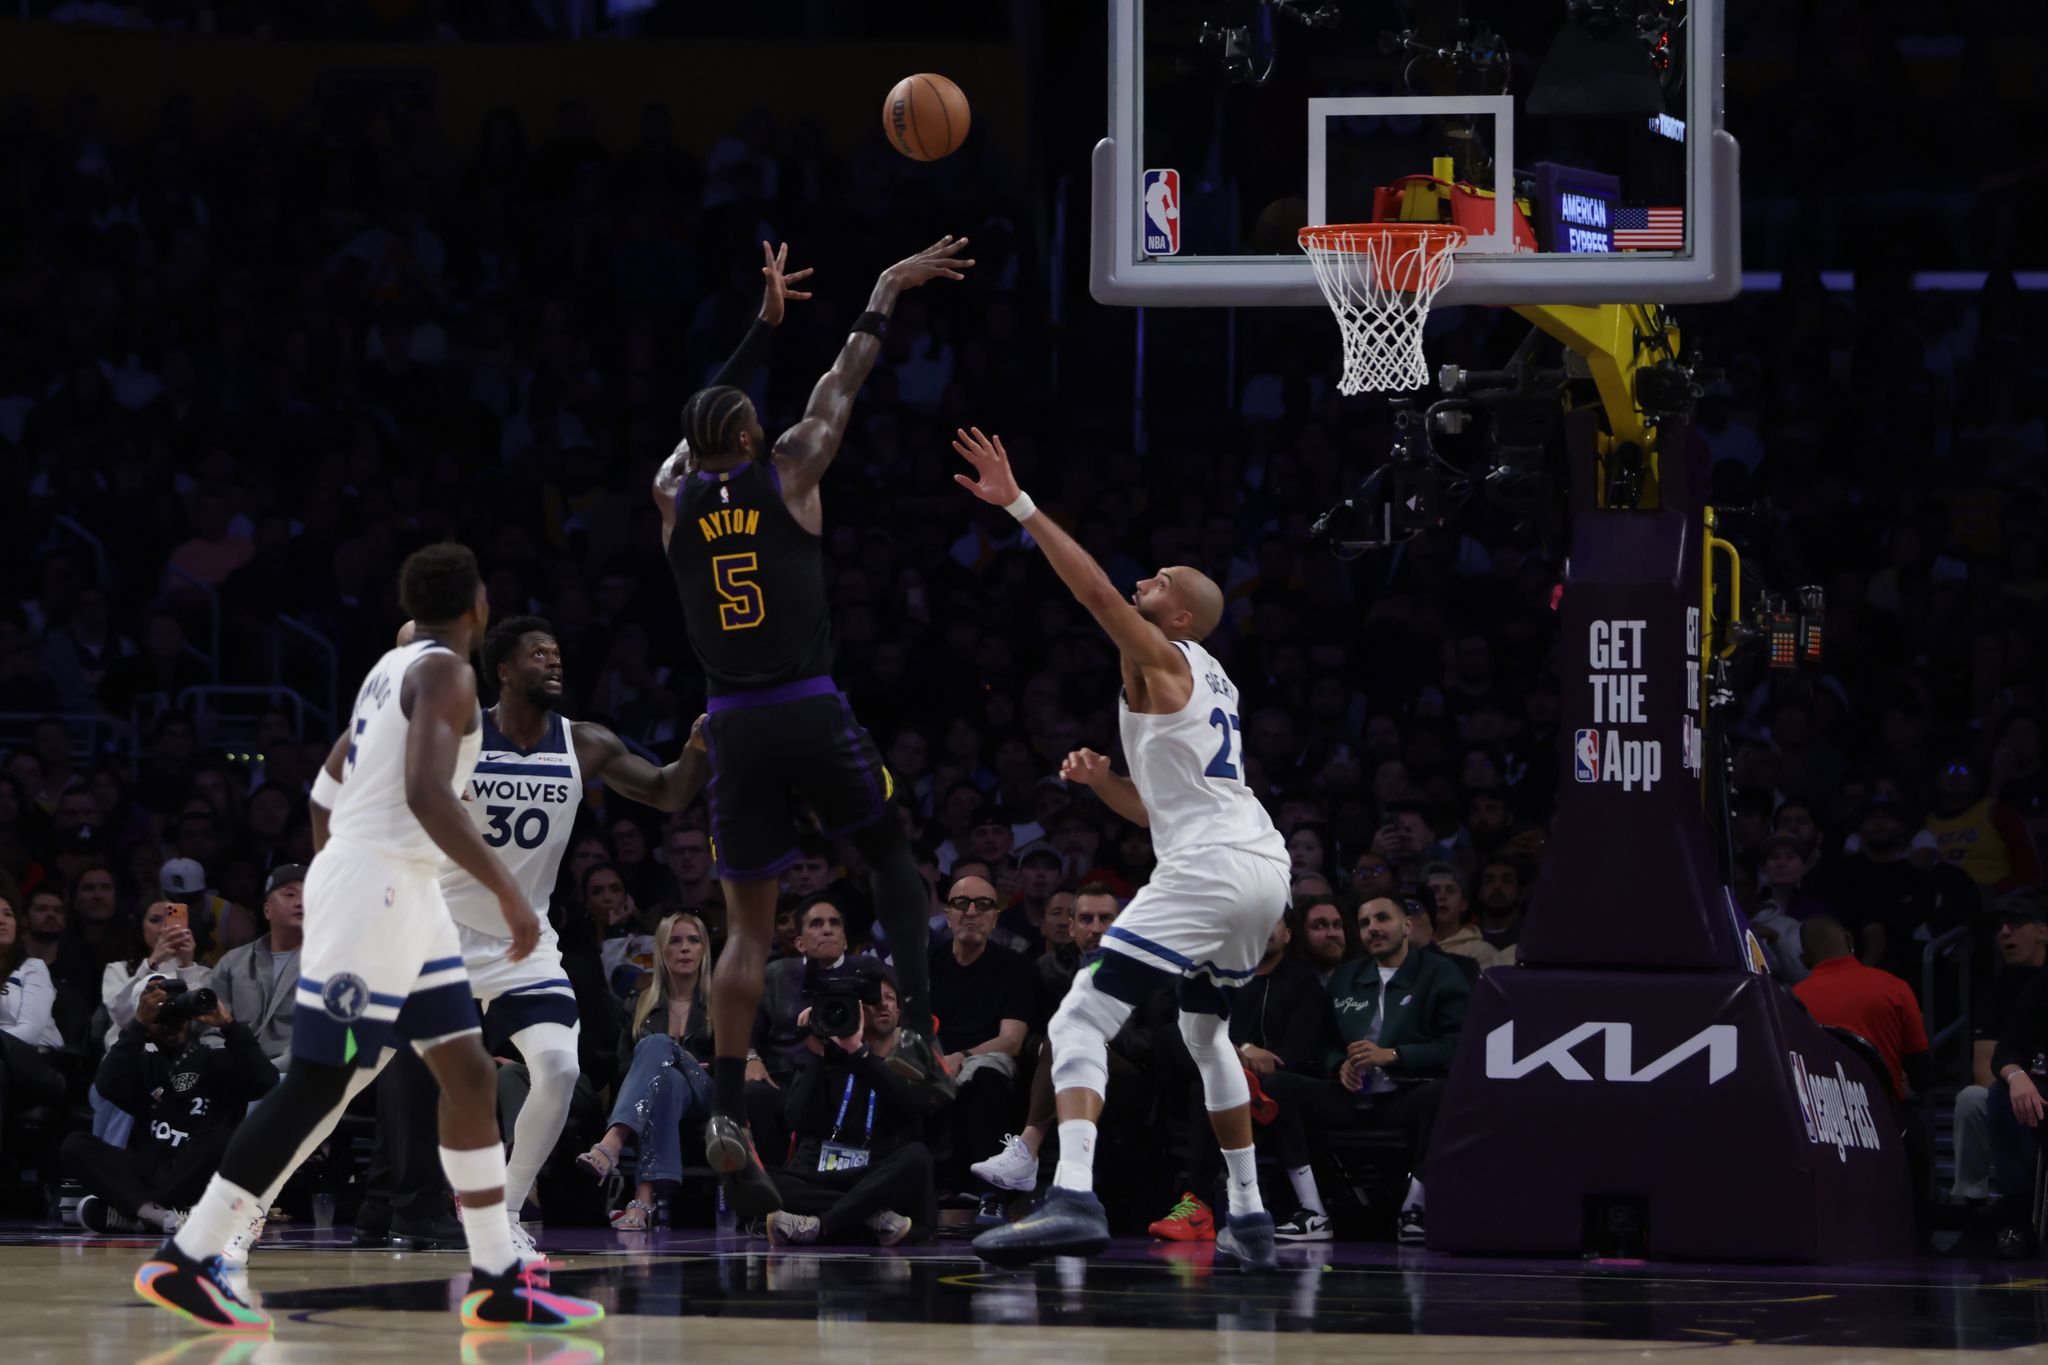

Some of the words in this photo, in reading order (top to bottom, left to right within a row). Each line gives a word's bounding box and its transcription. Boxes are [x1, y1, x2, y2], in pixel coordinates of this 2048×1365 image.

[1561, 192, 1607, 228] AMERICAN
[1148, 235, 1166, 249] NBA
[1569, 227, 1609, 253] EXPRESS
[698, 508, 760, 543] AYTON
[712, 551, 766, 631] 5
[1589, 619, 1647, 670] GET
[1588, 674, 1648, 723] THE
[1602, 730, 1662, 792] App
[472, 779, 568, 803] WOLVES
[482, 805, 549, 849] 30
